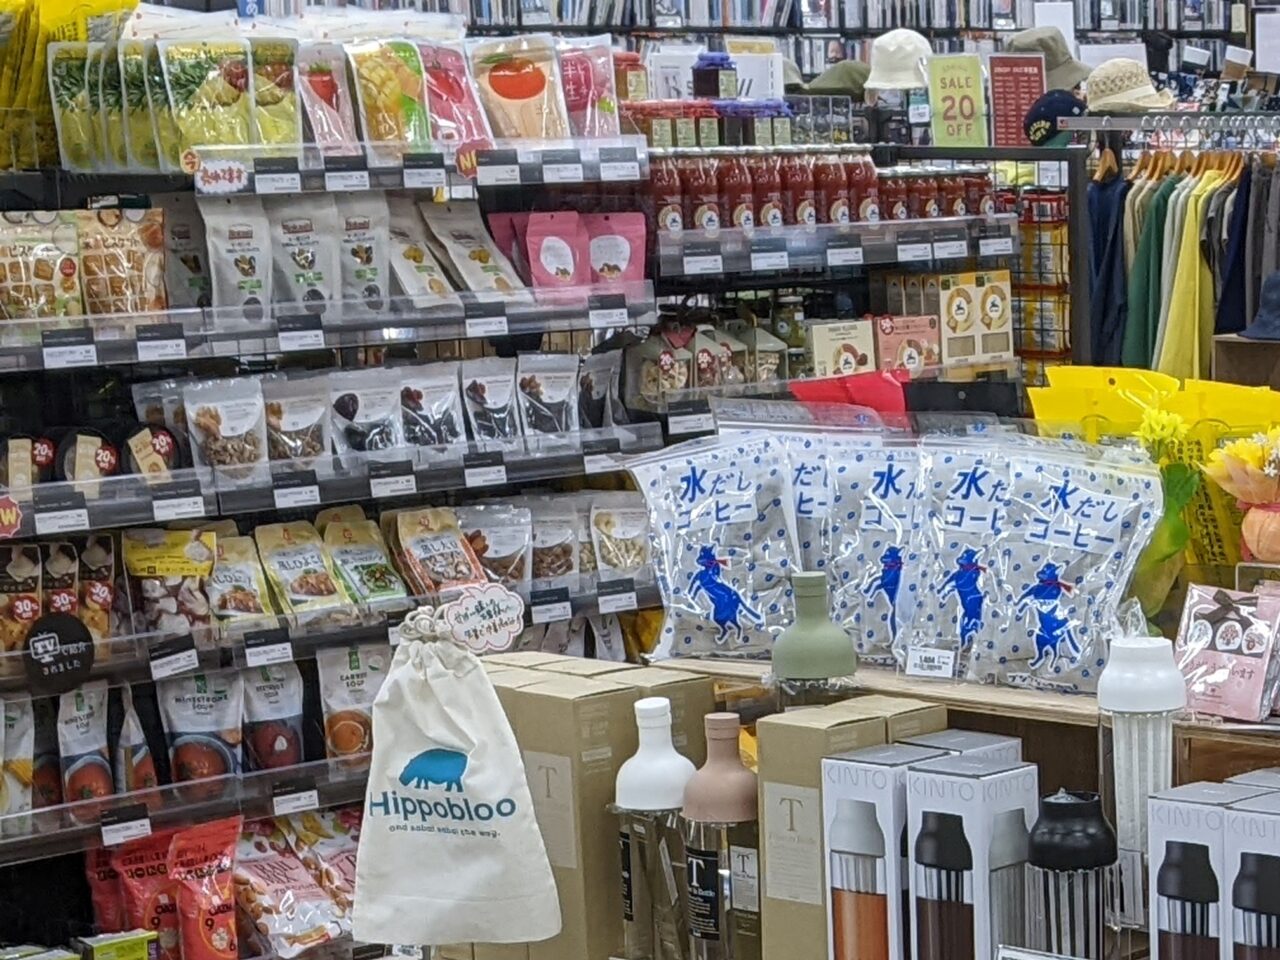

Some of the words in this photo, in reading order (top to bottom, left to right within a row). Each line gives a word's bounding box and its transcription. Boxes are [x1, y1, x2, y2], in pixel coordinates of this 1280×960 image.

[940, 77, 973, 90] SALE
[941, 94, 974, 121] 20
[946, 123, 973, 137] OFF
[680, 465, 752, 503] 水だし
[676, 499, 752, 531] コーヒー
[1040, 479, 1119, 523] 水だし
[1029, 516, 1115, 549] コーヒー
[909, 775, 976, 801] KINTO
[982, 772, 1036, 802] KINTO
[369, 790, 517, 822] Hippobloo
[1151, 804, 1223, 832] KINTO
[687, 857, 706, 888] T
